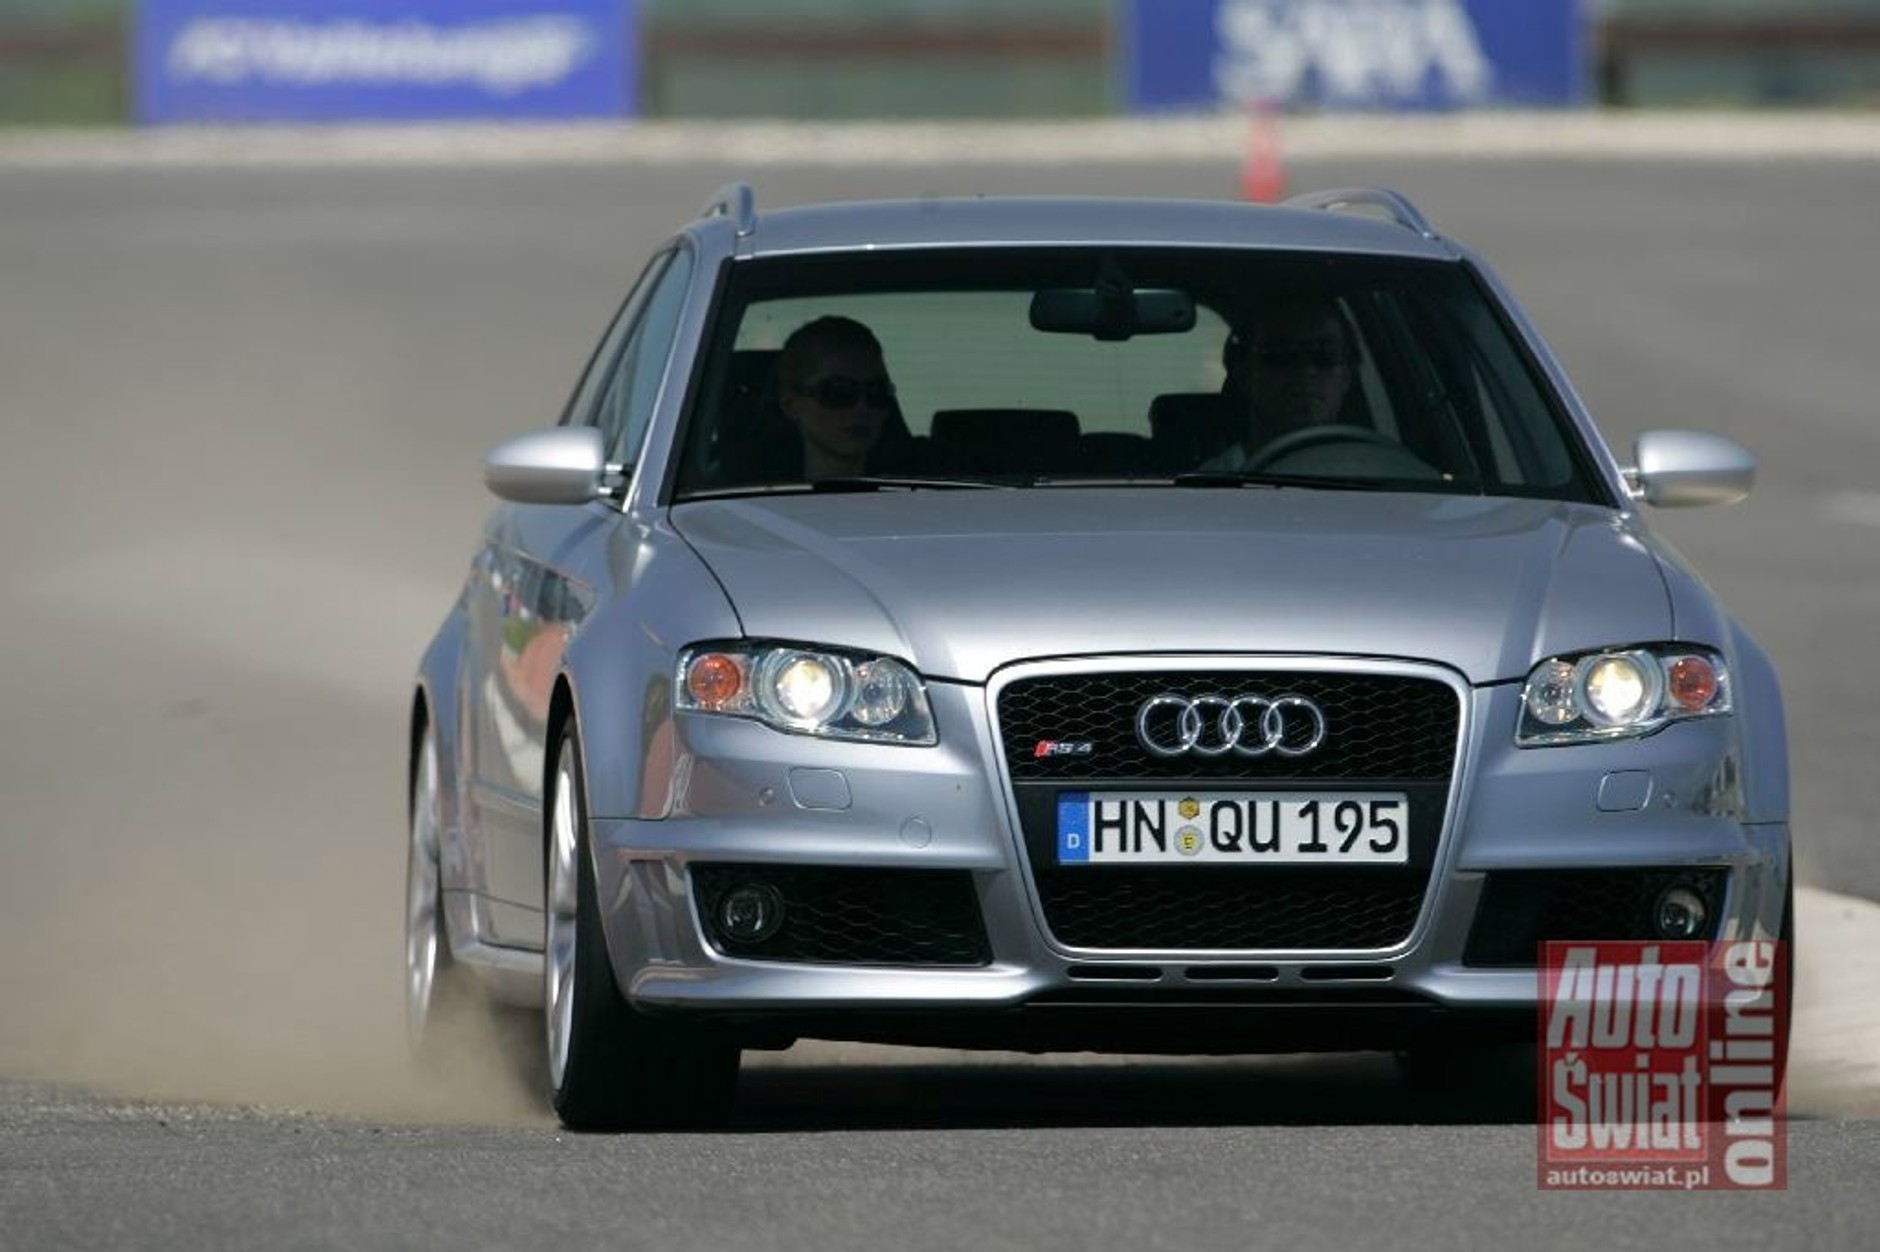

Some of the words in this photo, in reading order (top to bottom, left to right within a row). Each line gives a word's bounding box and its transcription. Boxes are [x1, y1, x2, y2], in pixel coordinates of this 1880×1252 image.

[1067, 833, 1080, 849] D
[1094, 800, 1165, 852] HN
[1210, 800, 1280, 852] QU
[1298, 800, 1400, 853] 195
